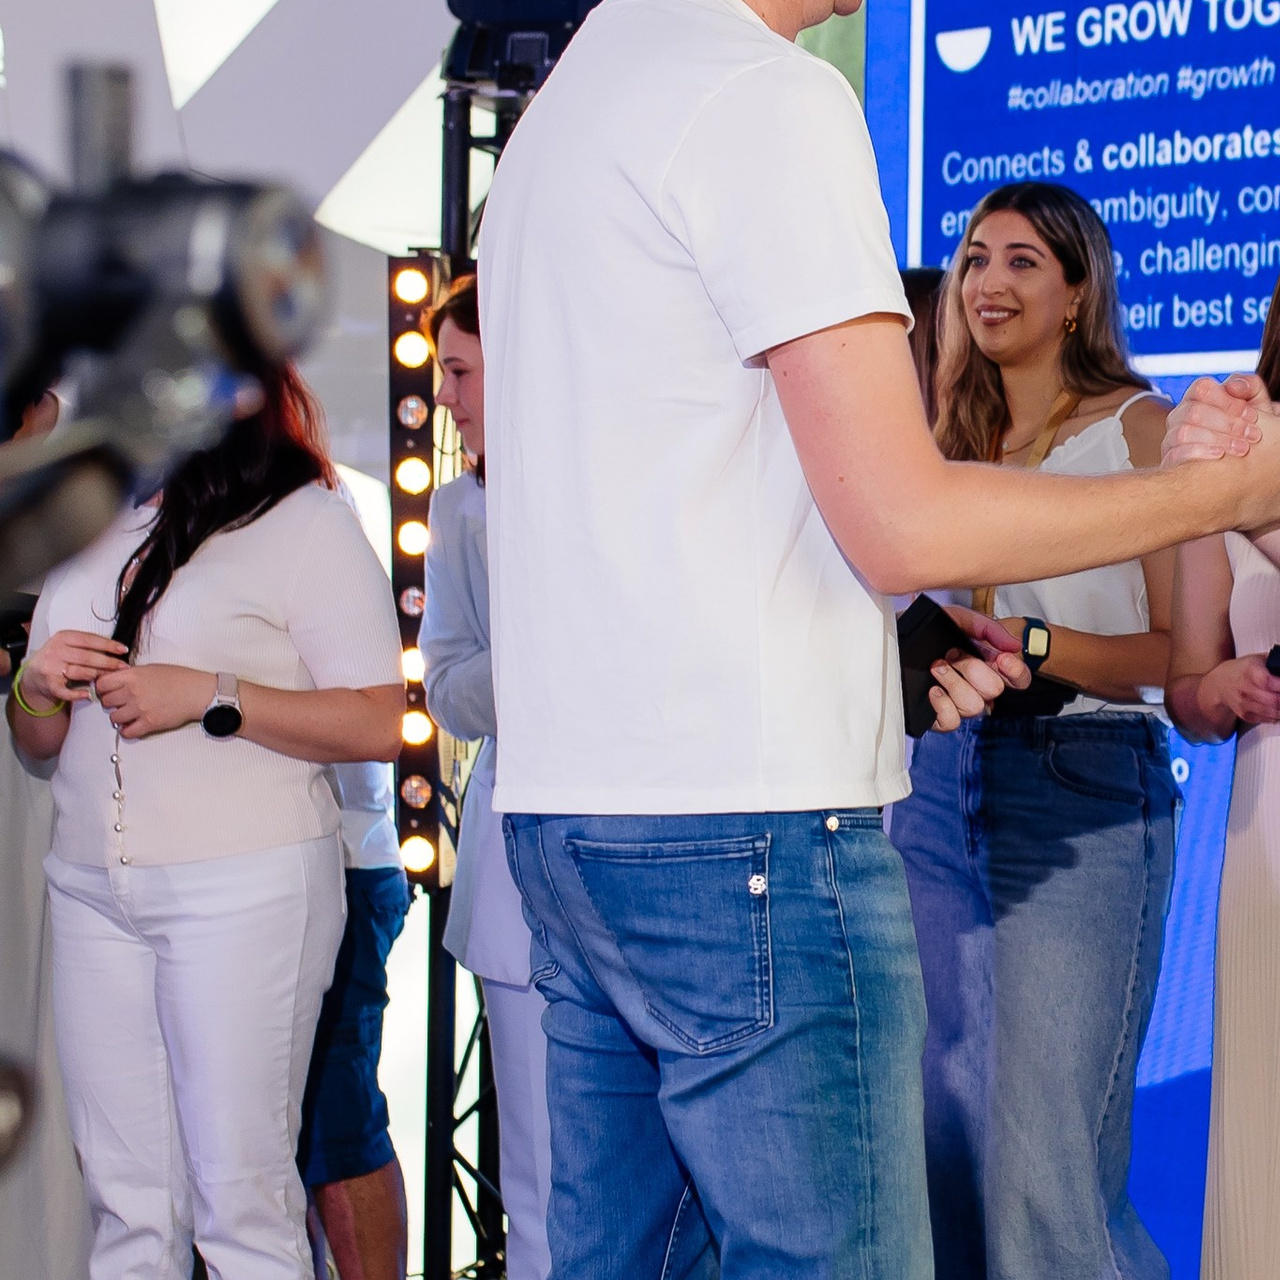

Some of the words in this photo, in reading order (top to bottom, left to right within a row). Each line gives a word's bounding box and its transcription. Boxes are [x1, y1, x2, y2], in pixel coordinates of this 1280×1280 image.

[1011, 11, 1066, 55] WE
[1008, 70, 1169, 110] #collaboration
[1176, 56, 1275, 99] #growth
[942, 145, 1066, 185] Connects
[1074, 138, 1093, 172] &
[1173, 292, 1233, 329] best
